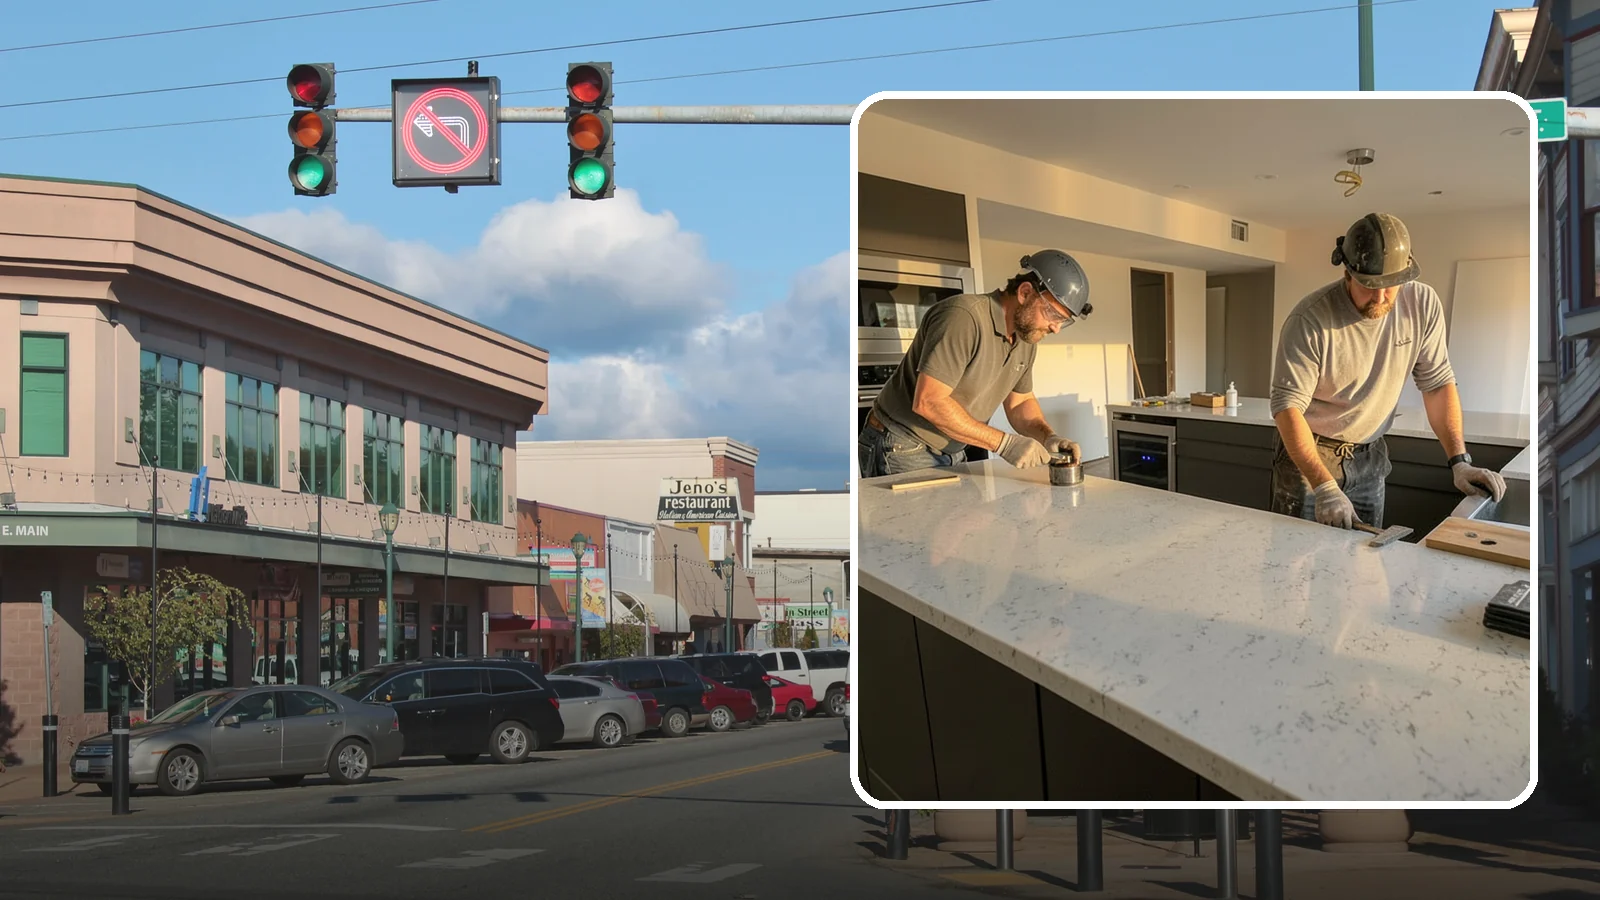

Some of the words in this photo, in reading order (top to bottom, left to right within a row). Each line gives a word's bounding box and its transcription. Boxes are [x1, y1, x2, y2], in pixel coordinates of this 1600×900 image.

[669, 480, 727, 494] Jeno's
[665, 496, 731, 509] restaurant
[658, 509, 681, 519] Italian
[685, 509, 714, 519] American
[714, 509, 738, 519] Cuisine
[2, 525, 13, 536] E.
[15, 525, 49, 536] MAIN
[797, 608, 828, 617] Street
